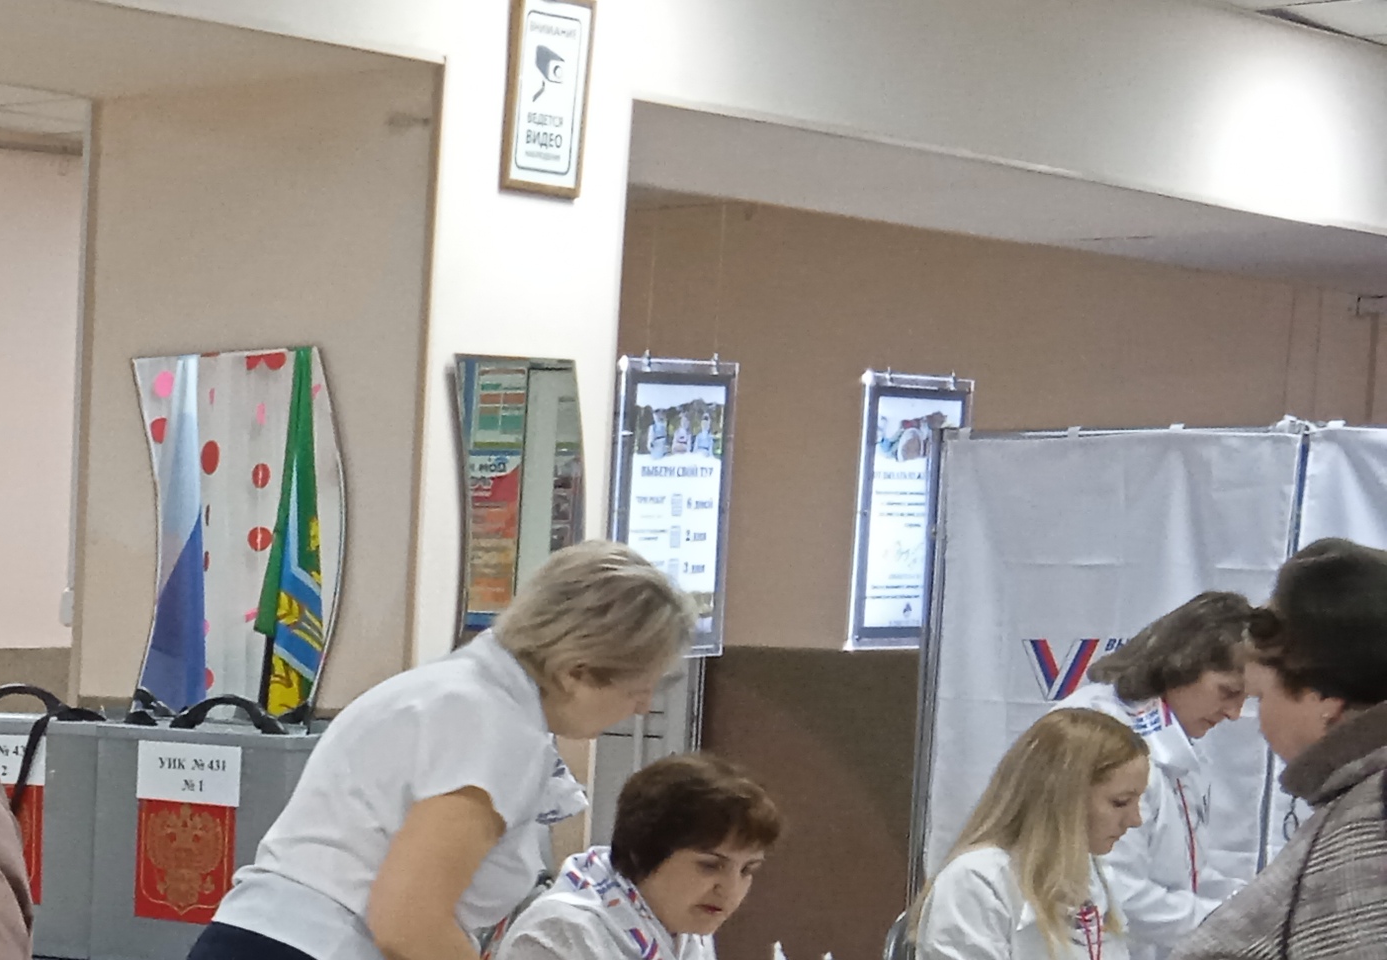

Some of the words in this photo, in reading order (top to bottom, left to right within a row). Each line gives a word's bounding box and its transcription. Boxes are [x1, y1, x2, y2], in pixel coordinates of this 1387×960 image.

[526, 128, 562, 150] ВИДЕО
[1, 764, 8, 777] 2
[158, 756, 186, 770] УИК
[191, 758, 205, 771] №
[207, 759, 226, 772] 431
[181, 779, 196, 792] №
